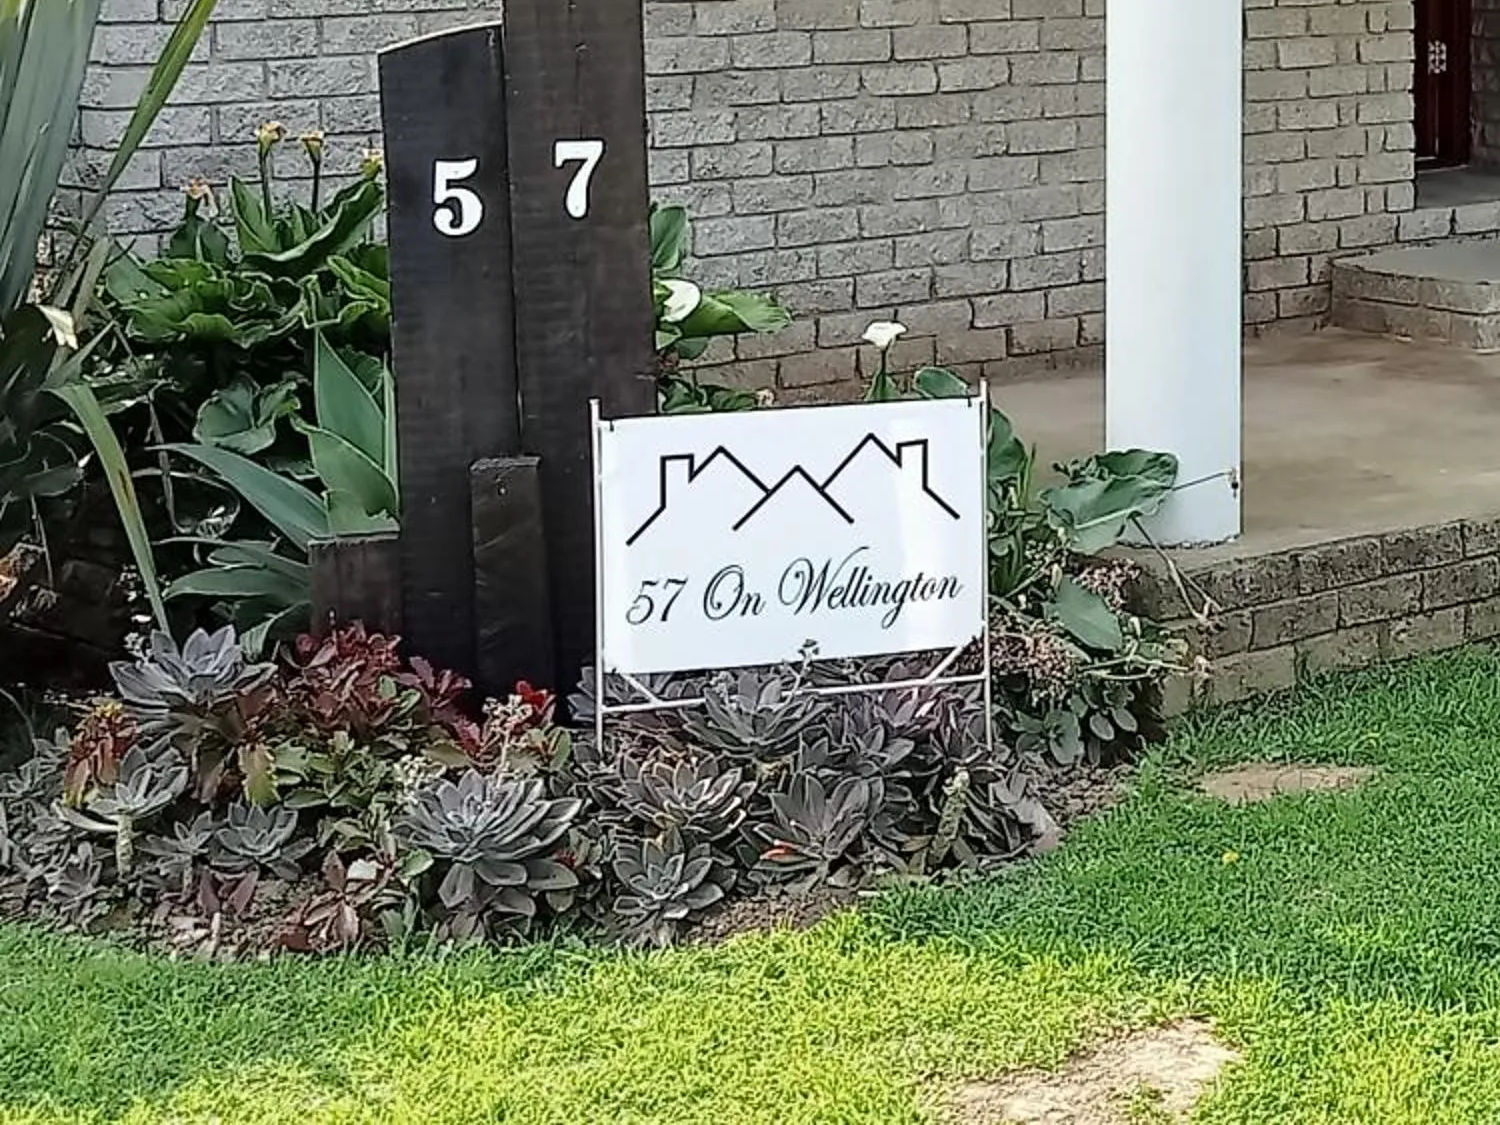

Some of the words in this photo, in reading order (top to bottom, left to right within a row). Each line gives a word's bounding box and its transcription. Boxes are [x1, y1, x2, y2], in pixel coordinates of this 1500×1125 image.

[433, 159, 483, 236] 5
[555, 140, 603, 218] 7
[626, 577, 689, 626] 57
[703, 565, 766, 620] On
[778, 547, 963, 630] Wellington
